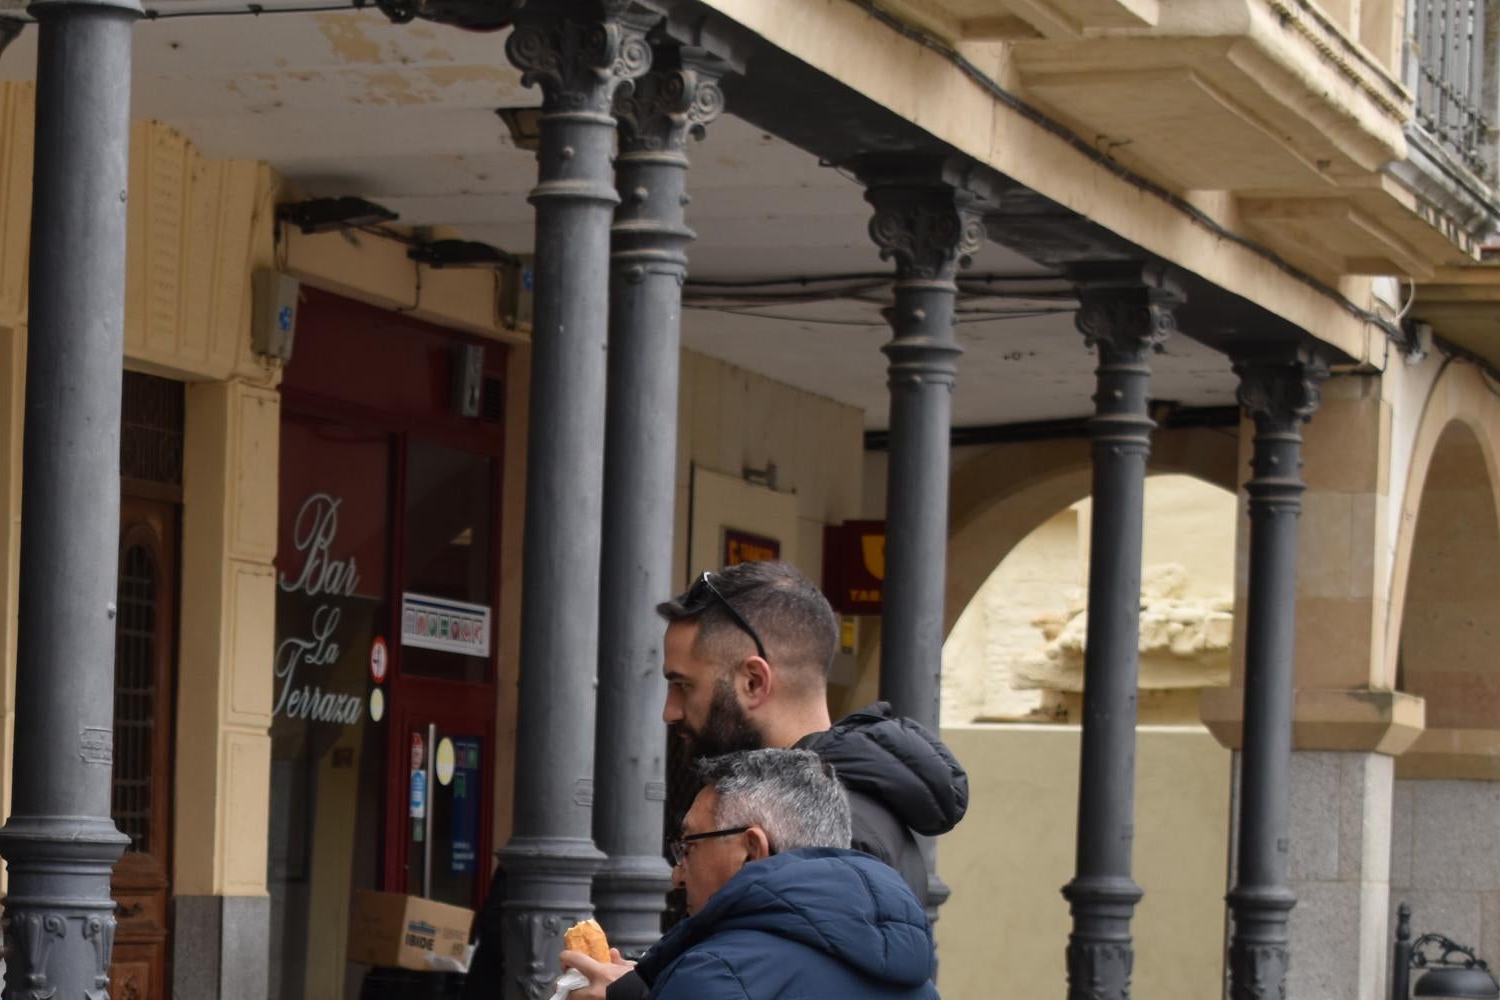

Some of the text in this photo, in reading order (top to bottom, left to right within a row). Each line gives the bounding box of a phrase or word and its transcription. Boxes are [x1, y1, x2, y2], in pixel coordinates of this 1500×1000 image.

[280, 493, 360, 596] Bar
[304, 604, 341, 666] La
[271, 636, 363, 725] Terraza
